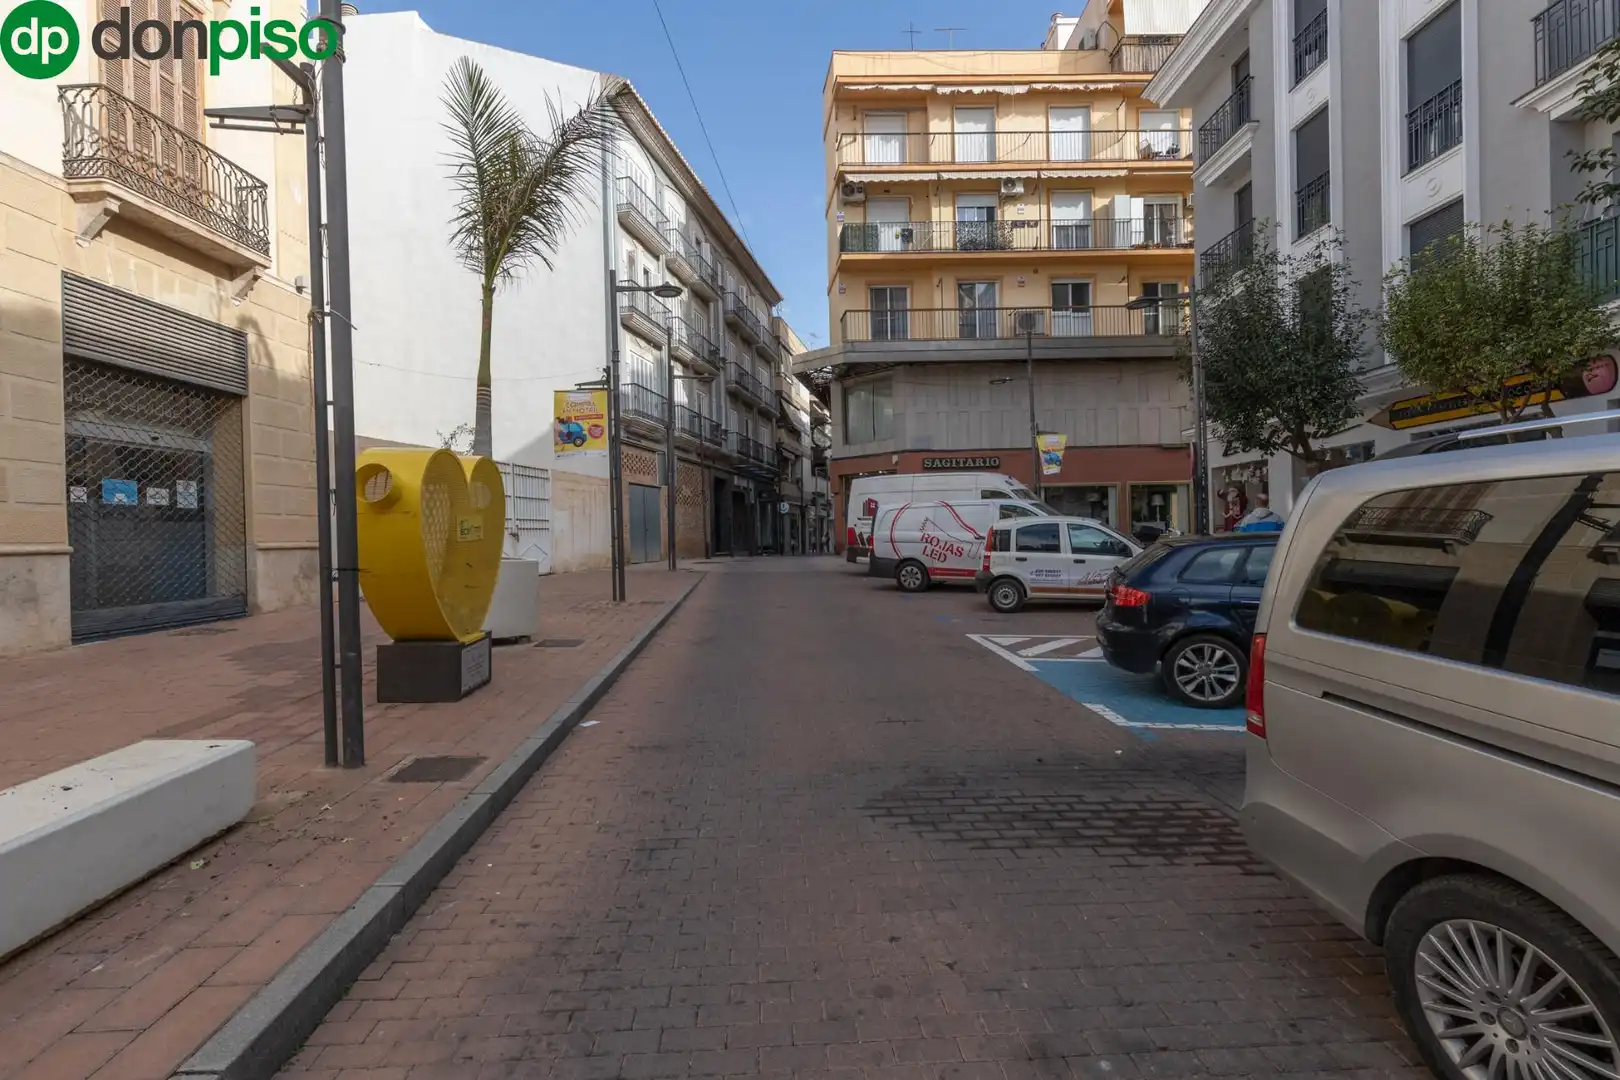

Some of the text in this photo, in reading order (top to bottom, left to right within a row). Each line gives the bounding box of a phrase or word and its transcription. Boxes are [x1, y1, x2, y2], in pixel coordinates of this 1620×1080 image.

[924, 457, 1000, 468] SAGITARIO
[920, 532, 964, 558] ROJAS
[922, 545, 947, 563] LED
